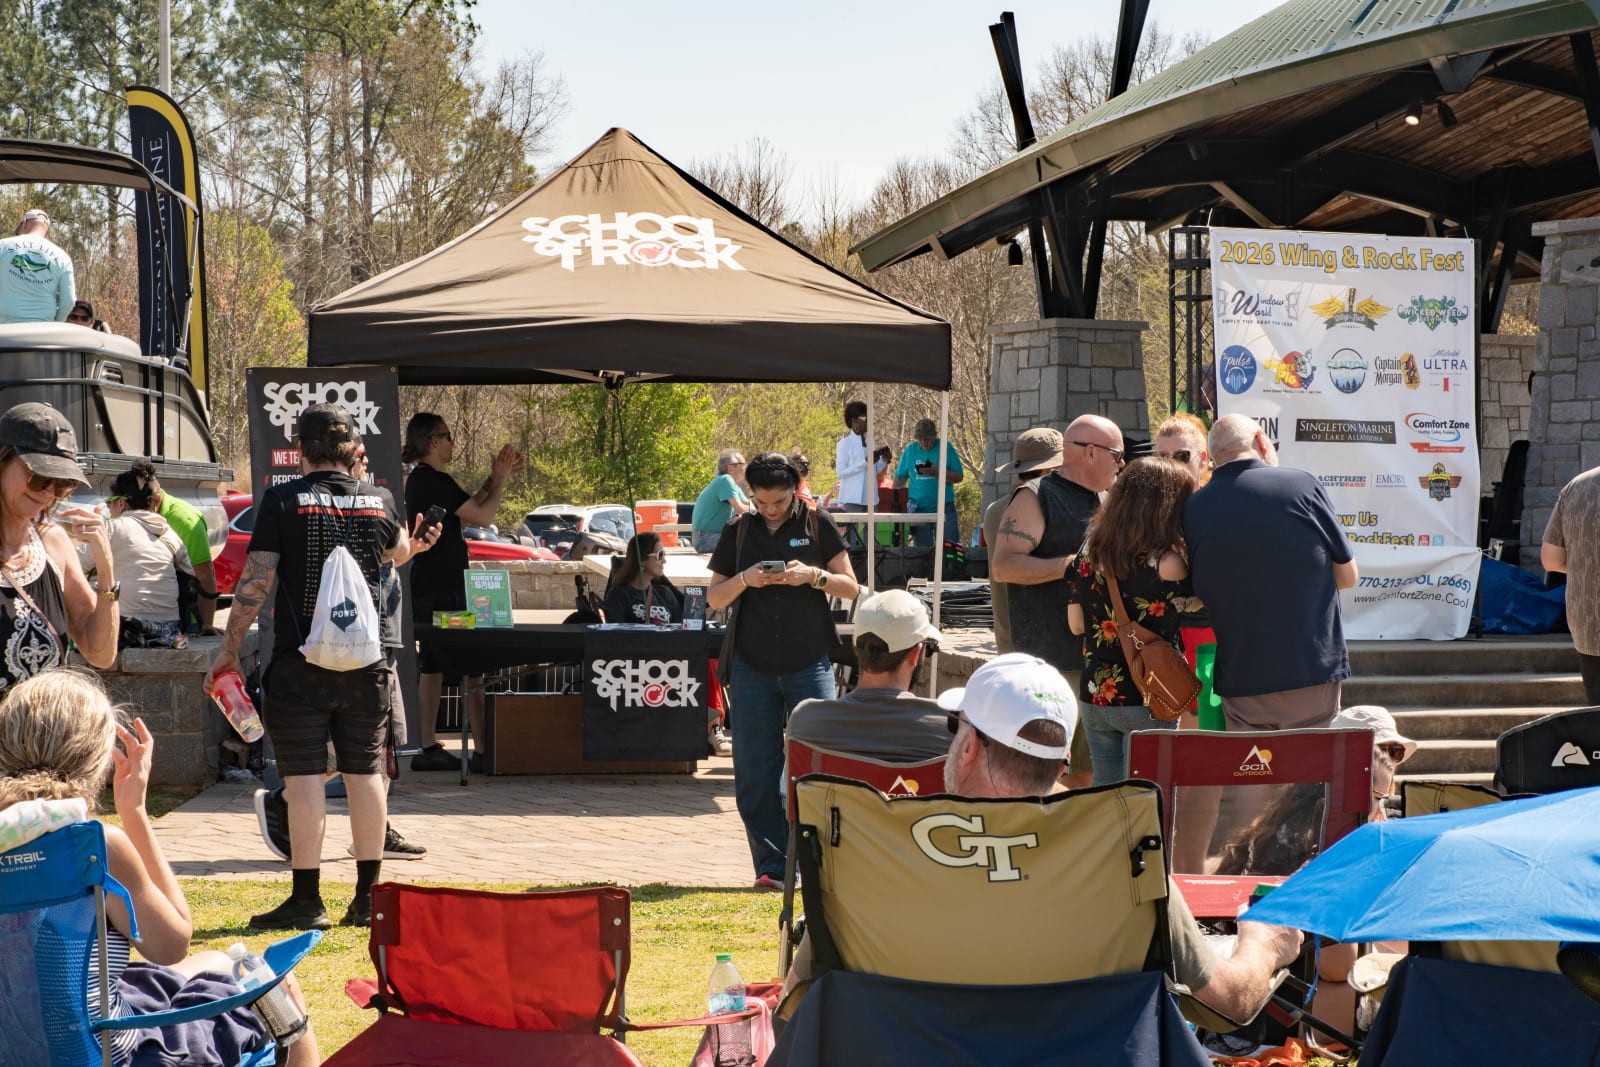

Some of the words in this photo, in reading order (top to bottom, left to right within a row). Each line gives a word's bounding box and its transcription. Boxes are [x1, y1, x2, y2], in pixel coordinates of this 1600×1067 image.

[521, 212, 731, 245] SCHOOL
[591, 238, 746, 271] ROCK
[1220, 241, 1275, 265] 2026
[1280, 243, 1337, 273] Wing
[1342, 246, 1359, 269] &
[1363, 246, 1417, 271] Rock
[1420, 249, 1464, 271] Fest
[1374, 356, 1401, 370] Captain
[1423, 359, 1468, 370] ULTRA
[1374, 371, 1403, 386] Morgan
[263, 381, 374, 411] SCHOOL
[1300, 420, 1357, 432] SINGLETON
[1359, 422, 1393, 434] MARINE
[1413, 419, 1447, 429] Comfort
[1449, 420, 1470, 429] Zone
[1325, 433, 1344, 441] LAKE
[274, 450, 287, 465] WE
[297, 493, 332, 506] BAD
[1358, 511, 1378, 526] Us
[1346, 532, 1414, 546] RockFest
[1437, 575, 1472, 593] (2665)
[592, 659, 696, 685] SCHOOL
[625, 682, 702, 707] ROCK
[1240, 763, 1265, 771] GCI
[910, 812, 1039, 883] GT
